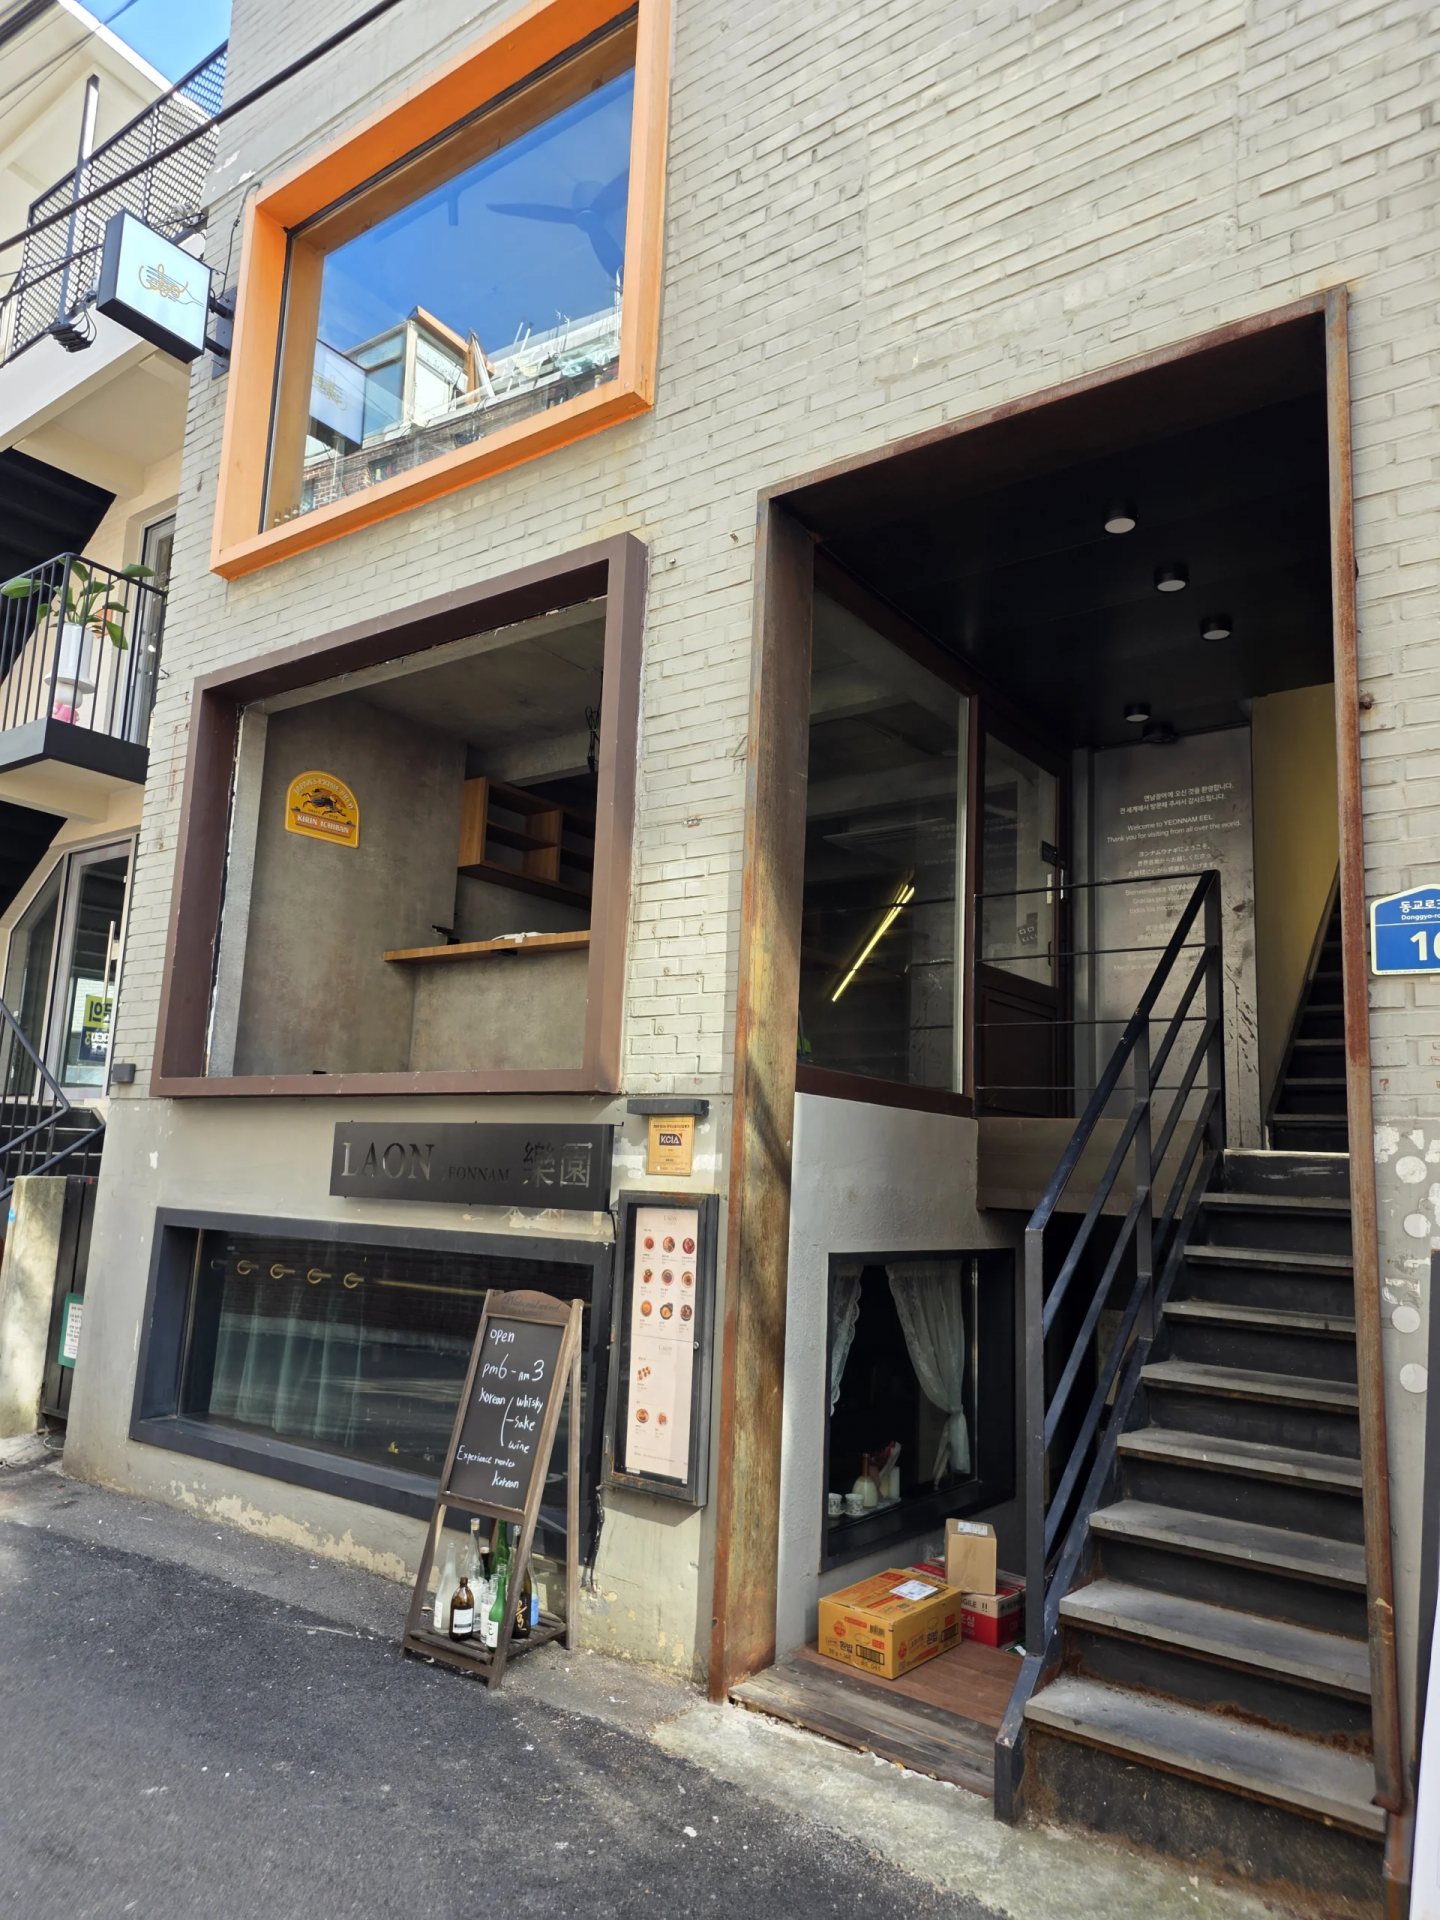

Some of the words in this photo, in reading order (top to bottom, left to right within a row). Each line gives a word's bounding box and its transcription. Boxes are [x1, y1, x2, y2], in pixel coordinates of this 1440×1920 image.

[1107, 836, 1125, 844] Thank
[1125, 834, 1137, 842] you
[1147, 828, 1169, 838] visiting
[1169, 827, 1185, 835] from
[1194, 824, 1208, 832] over
[1208, 822, 1220, 830] the
[1127, 821, 1155, 832] Welcome
[1163, 815, 1198, 827] YEONNAM
[661, 1135, 680, 1144] KCIA
[340, 1141, 436, 1181] LAON
[456, 1444, 493, 1465] Experience
